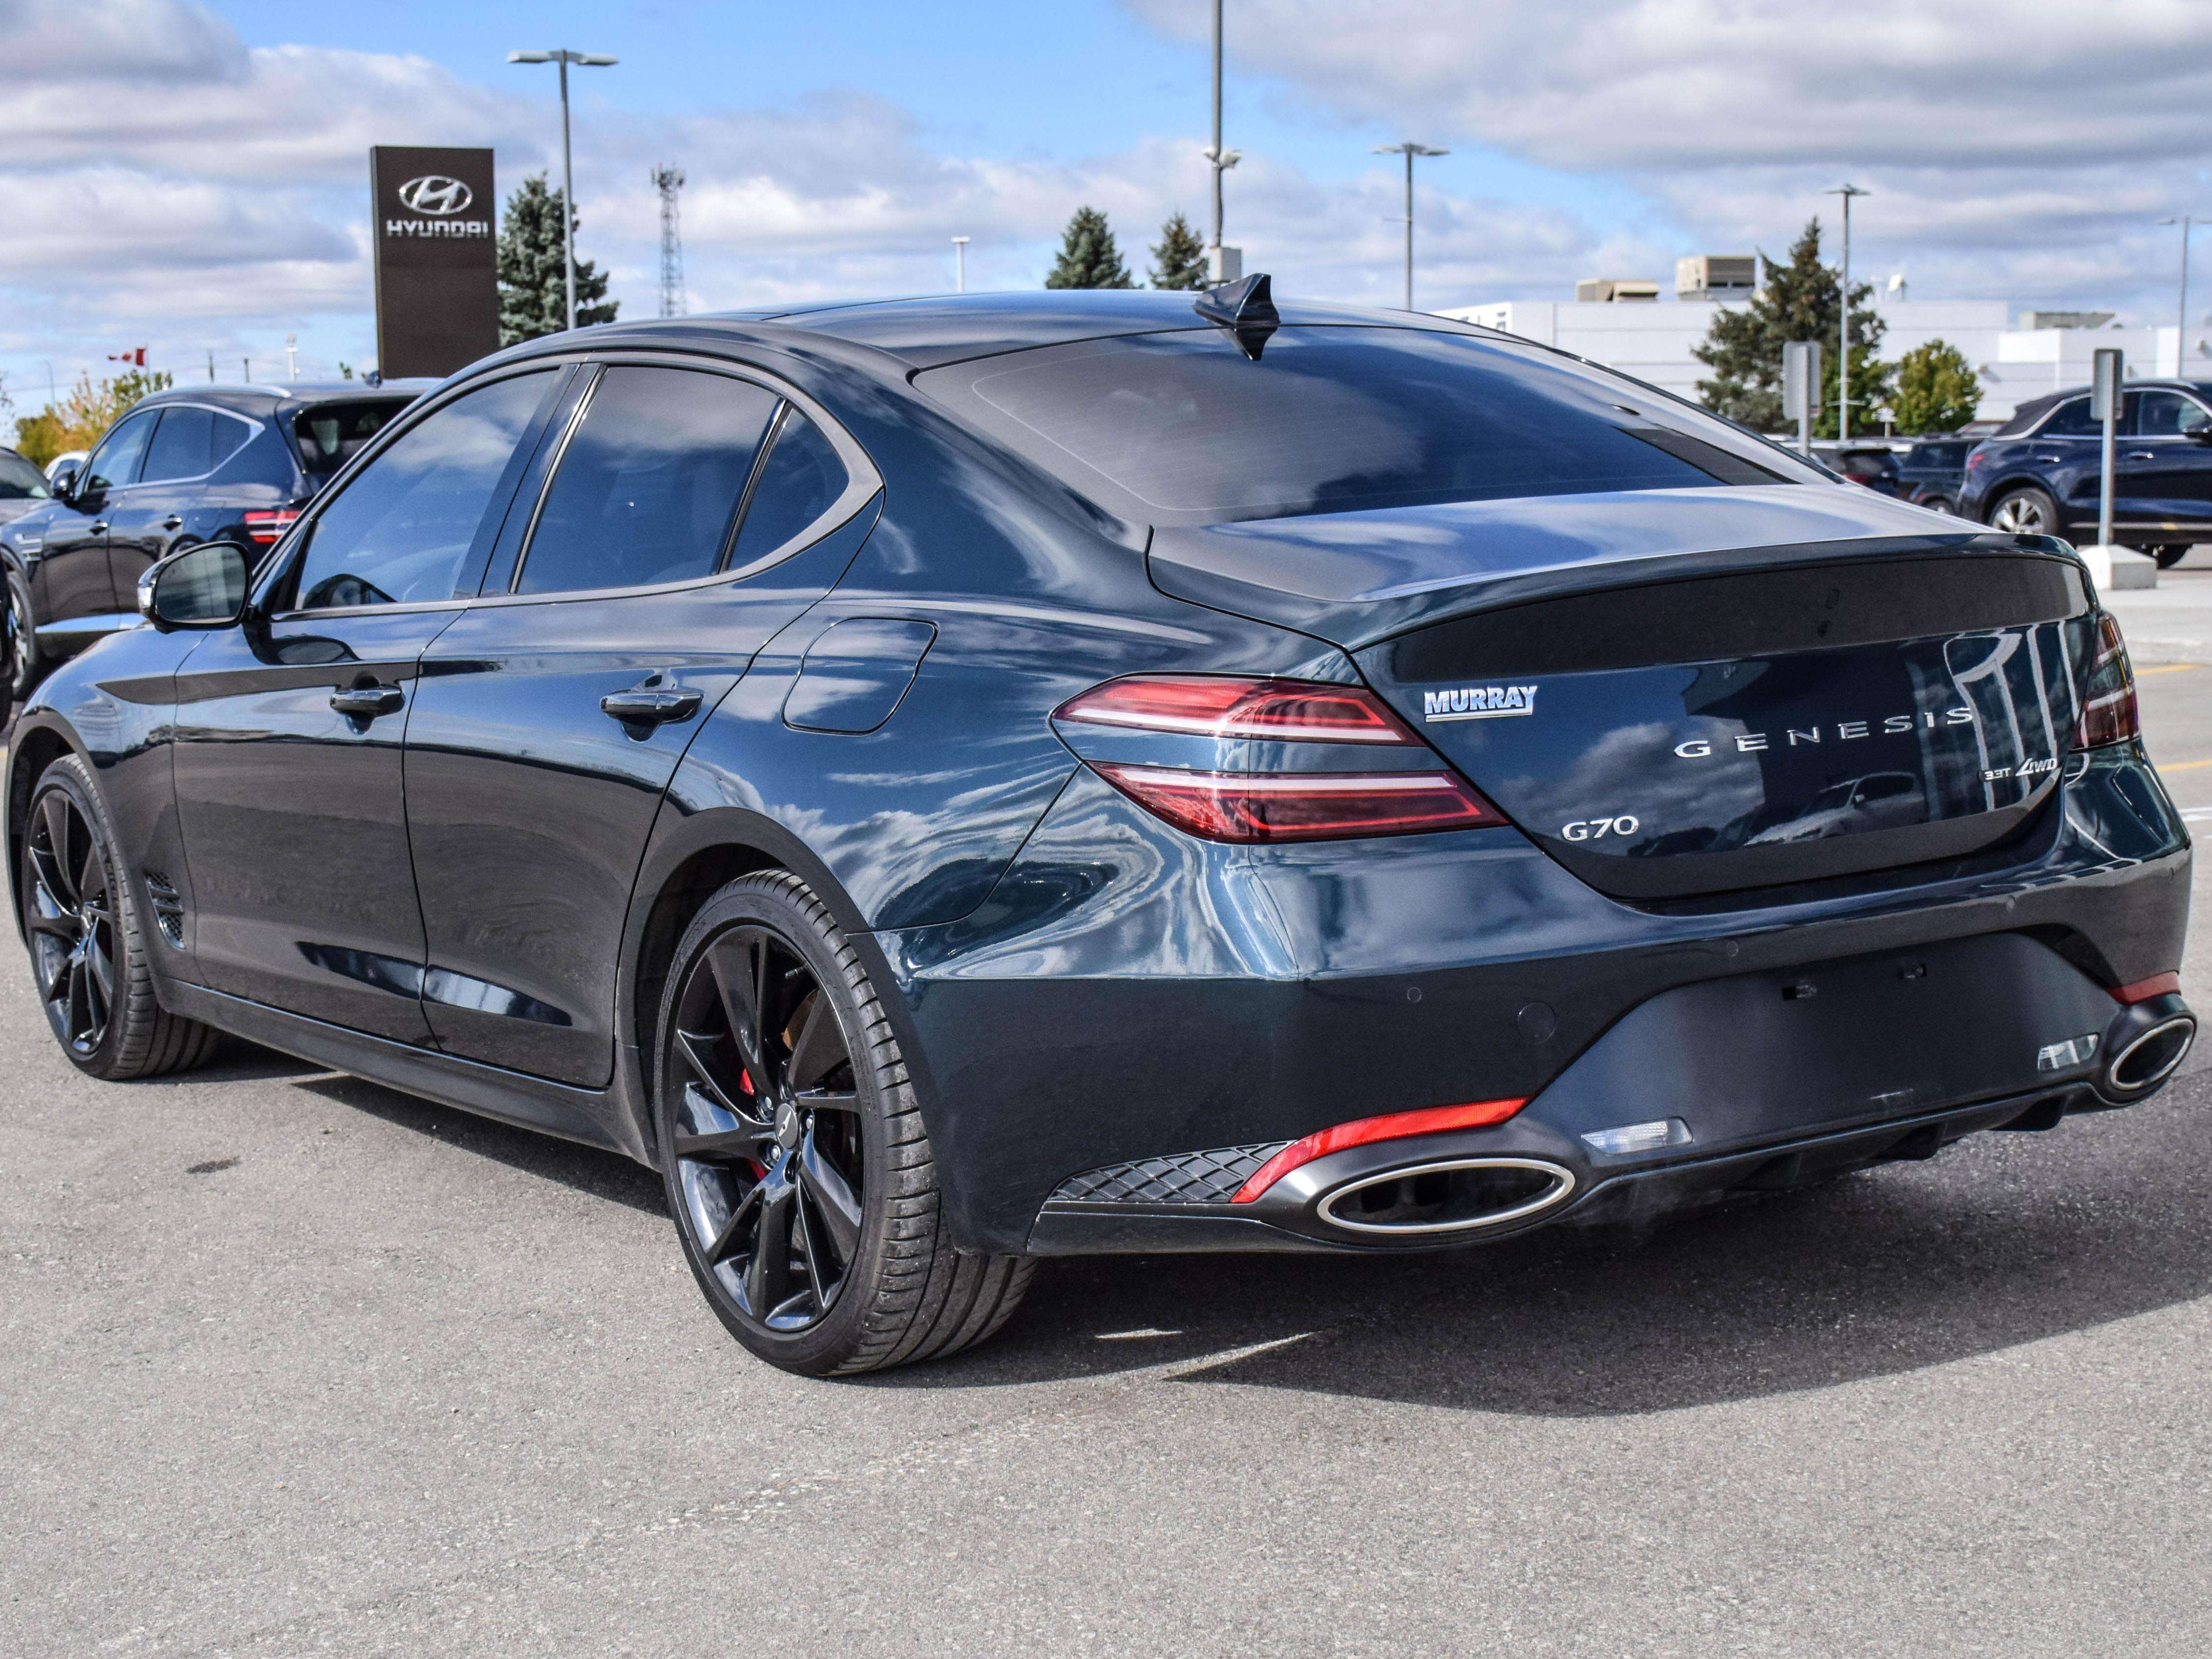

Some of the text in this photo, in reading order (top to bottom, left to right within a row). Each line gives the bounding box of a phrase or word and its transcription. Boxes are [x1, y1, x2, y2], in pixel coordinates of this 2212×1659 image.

[386, 220, 489, 237] HYUNDAI
[1424, 685, 1538, 715] MURRAY
[1674, 707, 1972, 758] GENESIS
[1562, 815, 1639, 841] G70
